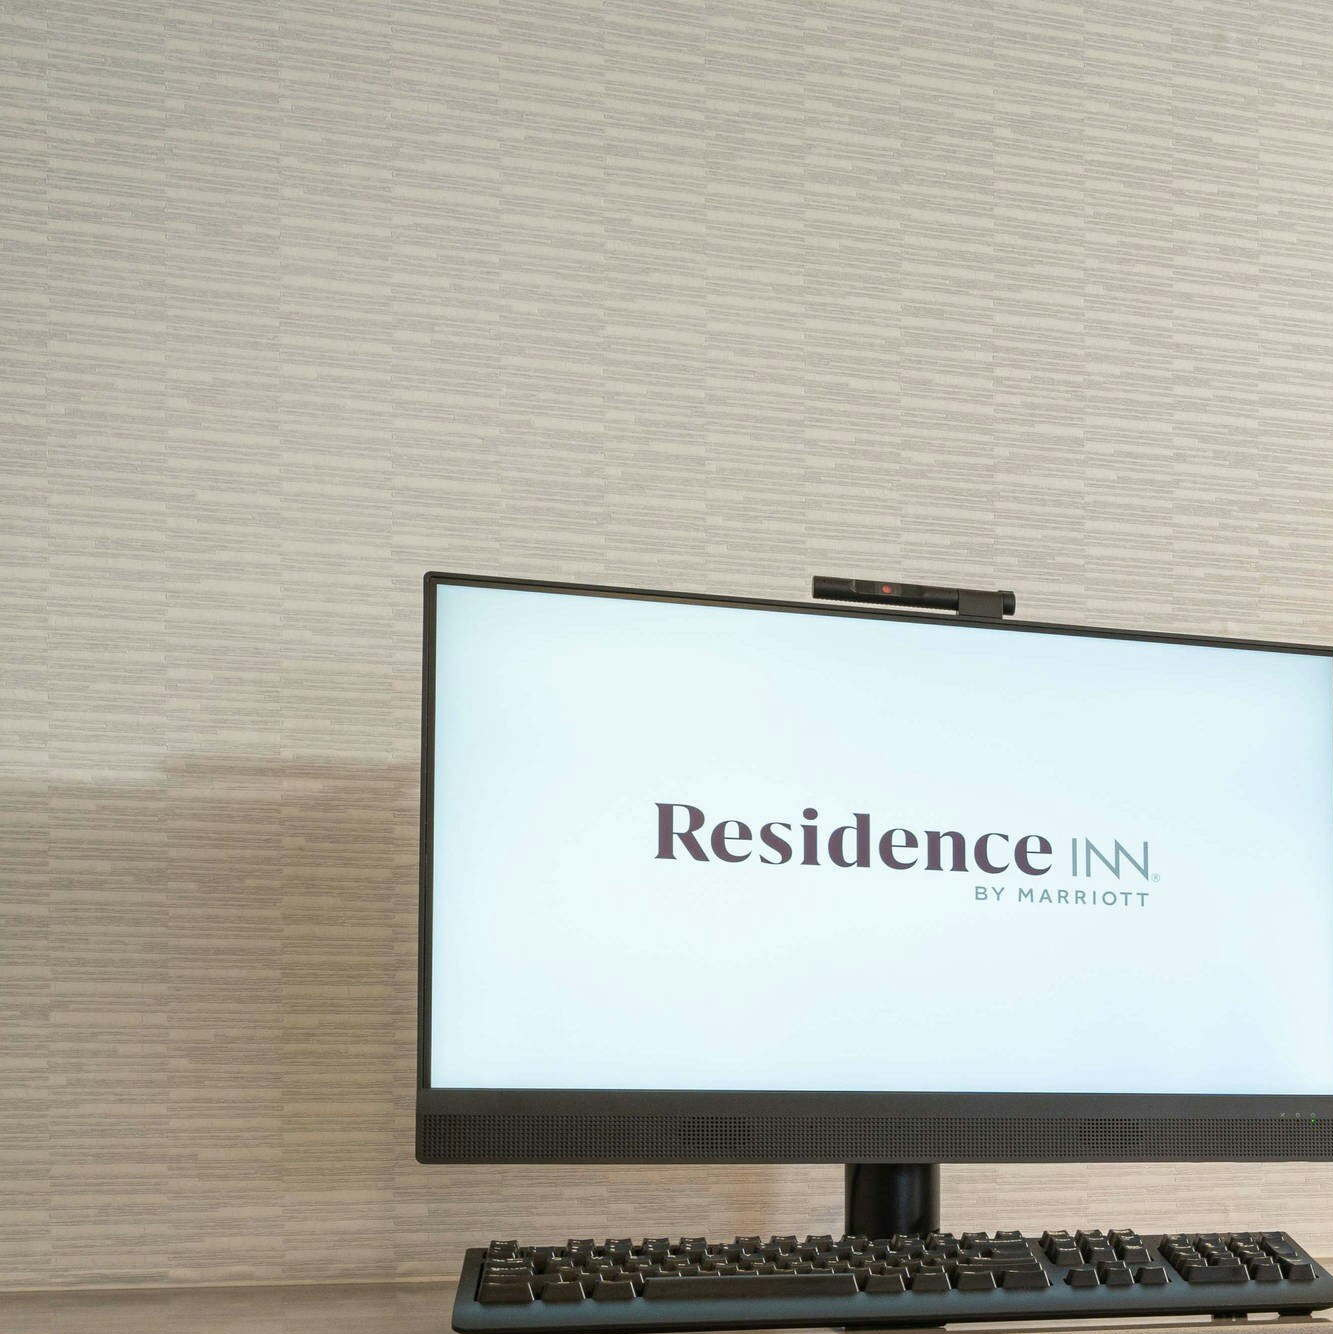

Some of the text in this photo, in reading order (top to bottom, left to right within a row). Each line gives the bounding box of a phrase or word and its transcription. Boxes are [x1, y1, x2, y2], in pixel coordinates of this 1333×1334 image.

[654, 802, 1053, 876] Residence
[974, 886, 1150, 907] BY MARRIOTT
